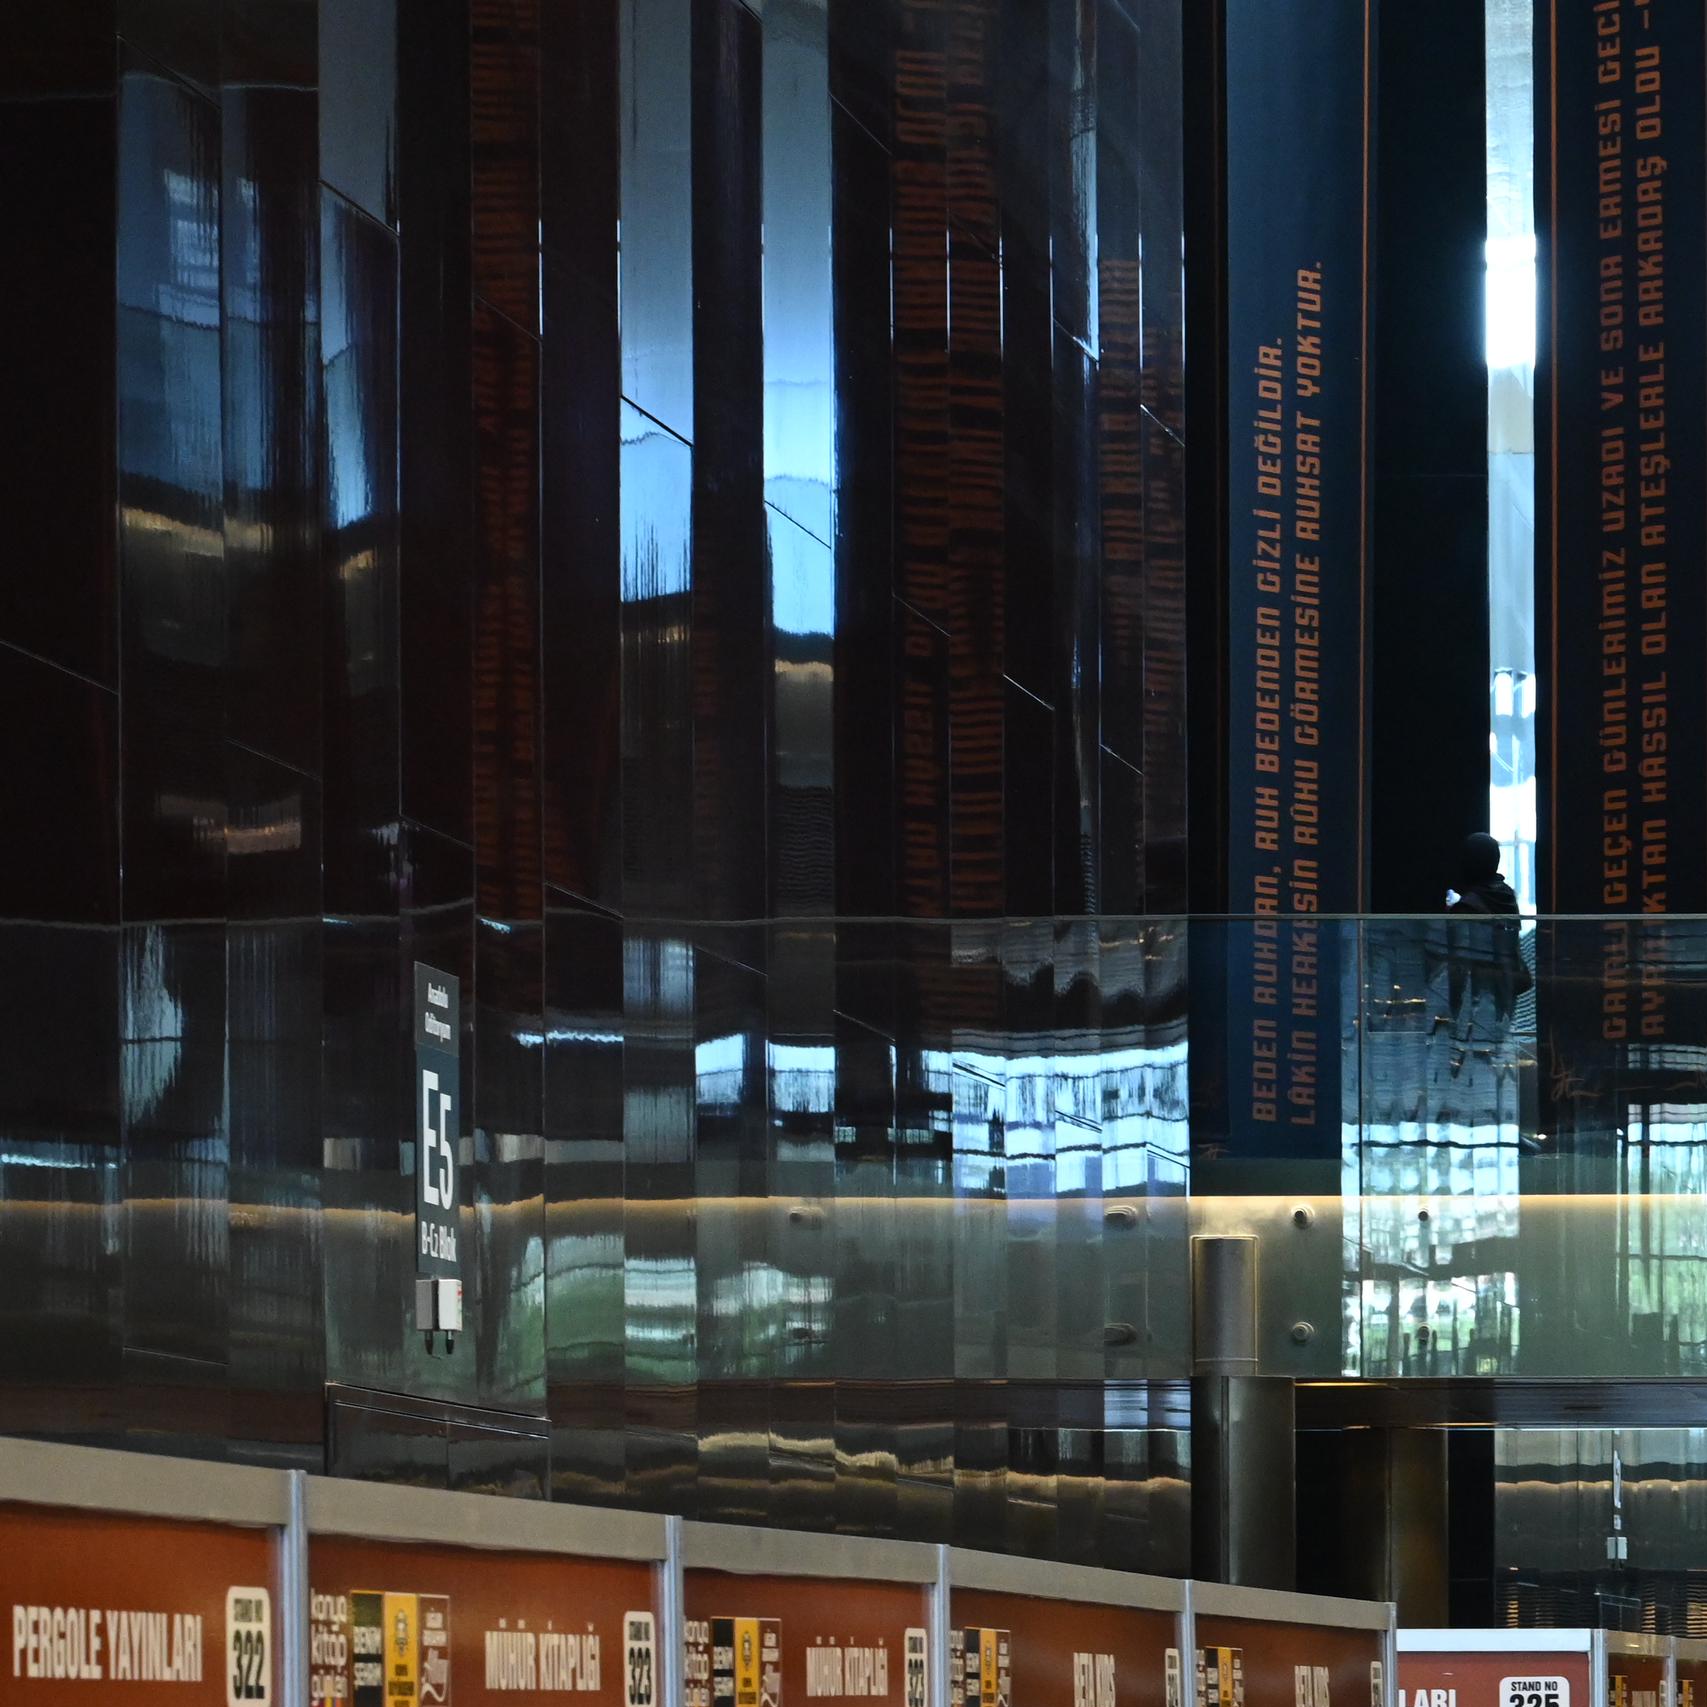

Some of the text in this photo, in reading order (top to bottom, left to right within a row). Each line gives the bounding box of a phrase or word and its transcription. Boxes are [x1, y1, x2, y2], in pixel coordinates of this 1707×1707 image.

[1635, 45, 1663, 140] OLDU
[1598, 97, 1624, 239] ERMESİ
[1636, 153, 1669, 326] ARKADAŞ
[1296, 261, 1323, 398] YOKTUR.
[1599, 253, 1625, 351] SONA
[1602, 366, 1627, 410] VE
[1640, 342, 1671, 546] ATEŞLERLE
[1295, 410, 1322, 542] RUHSAT
[1601, 425, 1628, 533] UZADI
[1289, 553, 1322, 748] GÖRMESİNE
[1599, 549, 1630, 774] GÜNLERİMİZ
[1641, 560, 1669, 656] OLAN
[1252, 337, 1283, 1122] BEDEN RUHDAN, RUH BEDENDEN GİZLİ DEĞİLDİR.
[1640, 670, 1670, 803] HÂSSIL
[1288, 756, 1320, 846] RÛHU
[1603, 787, 1634, 905] GEÇEN
[1286, 1030, 1318, 1126] LÂKİN
[422, 1069, 454, 1210] E5
[12, 1604, 204, 1683] PERGOLE YAYINLARI
[232, 1629, 265, 1701] 322
[627, 1646, 653, 1705] 323
[1511, 1681, 1558, 1692] STAND NO
